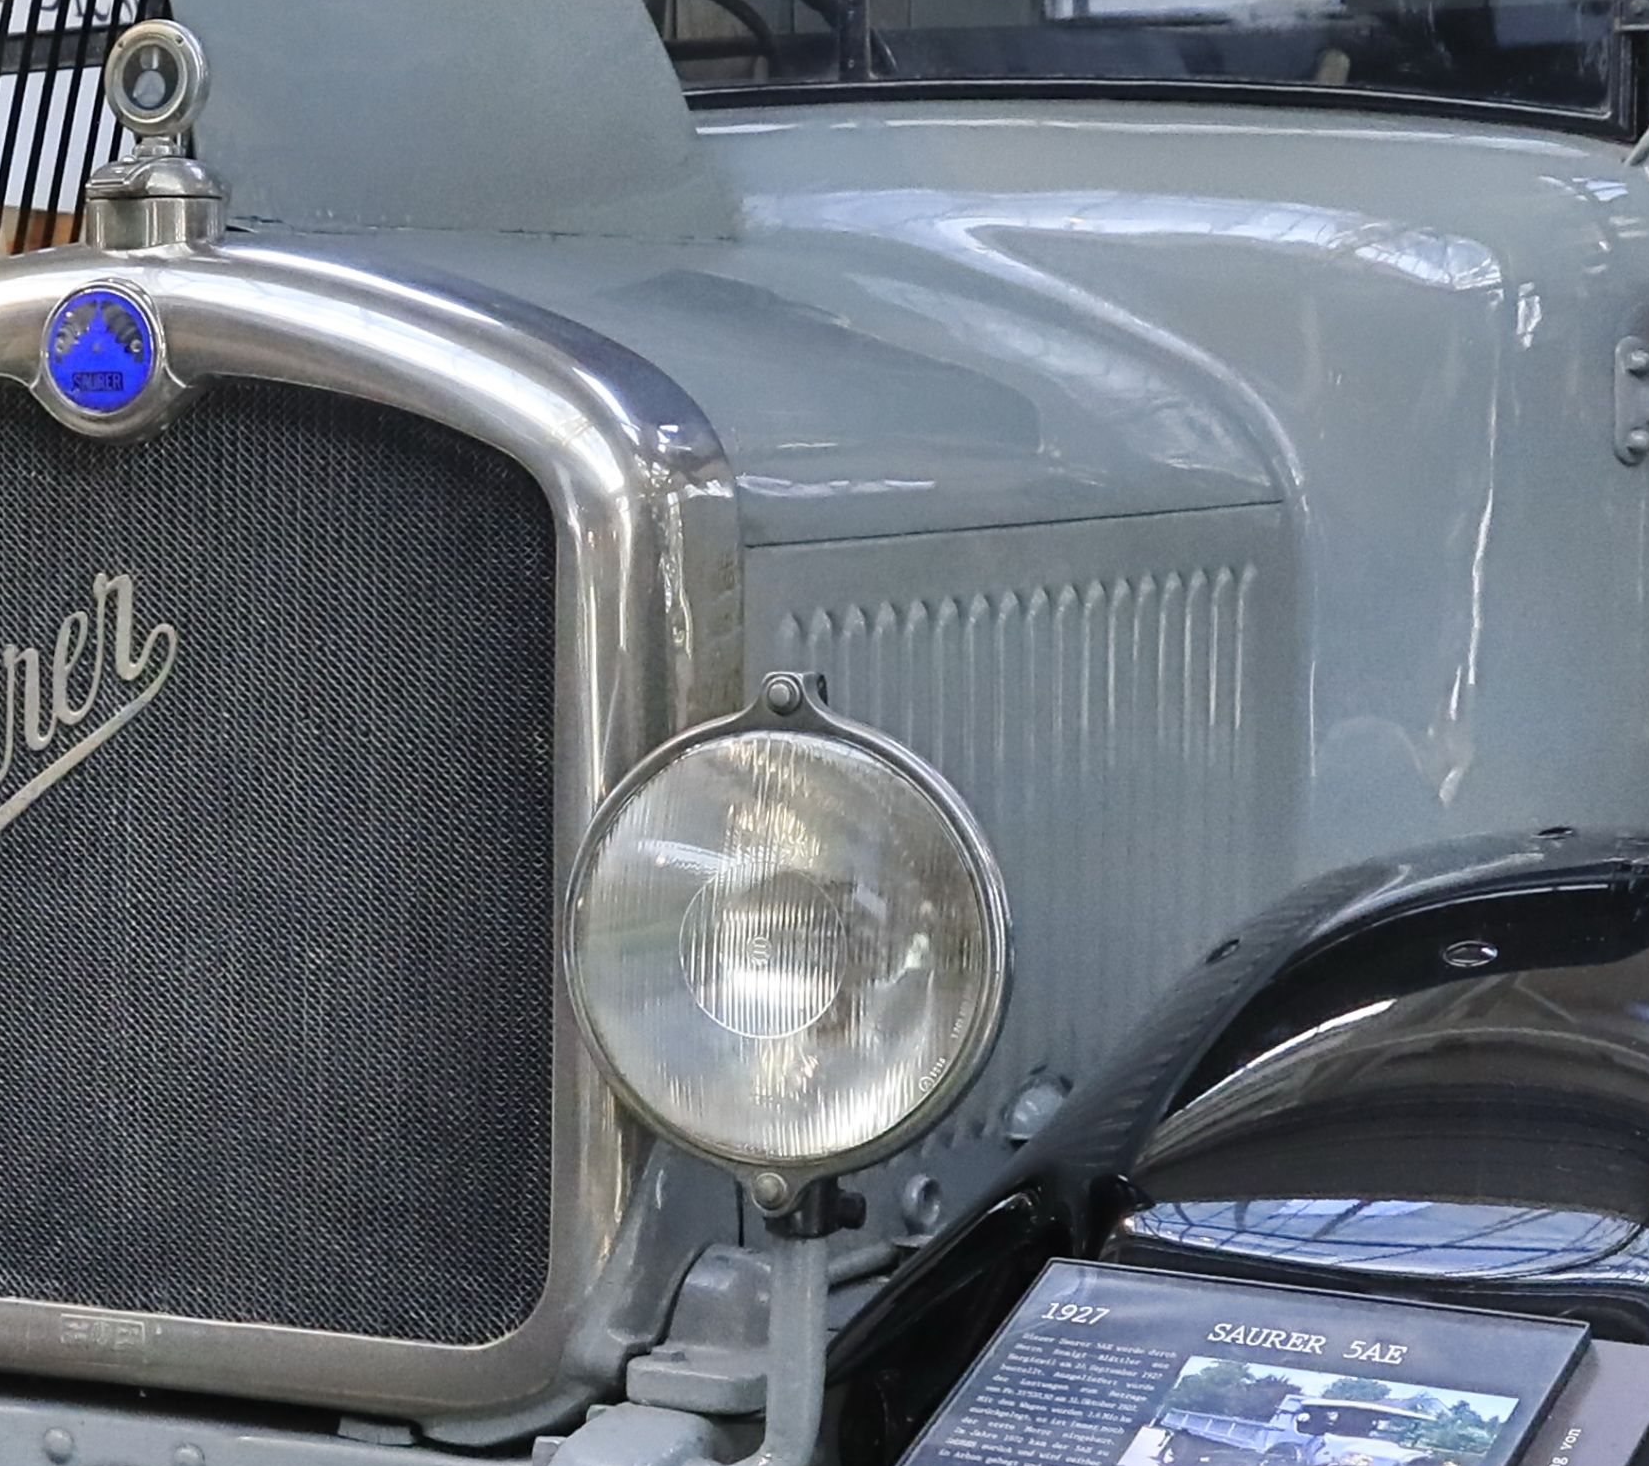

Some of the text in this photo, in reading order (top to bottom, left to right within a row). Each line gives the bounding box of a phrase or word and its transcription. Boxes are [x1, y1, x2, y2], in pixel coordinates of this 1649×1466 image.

[72, 372, 123, 391] SAURER
[1039, 1301, 1111, 1325] 1927
[1204, 1322, 1411, 1364] SAURER 5AE
[1560, 1427, 1582, 1452] von
